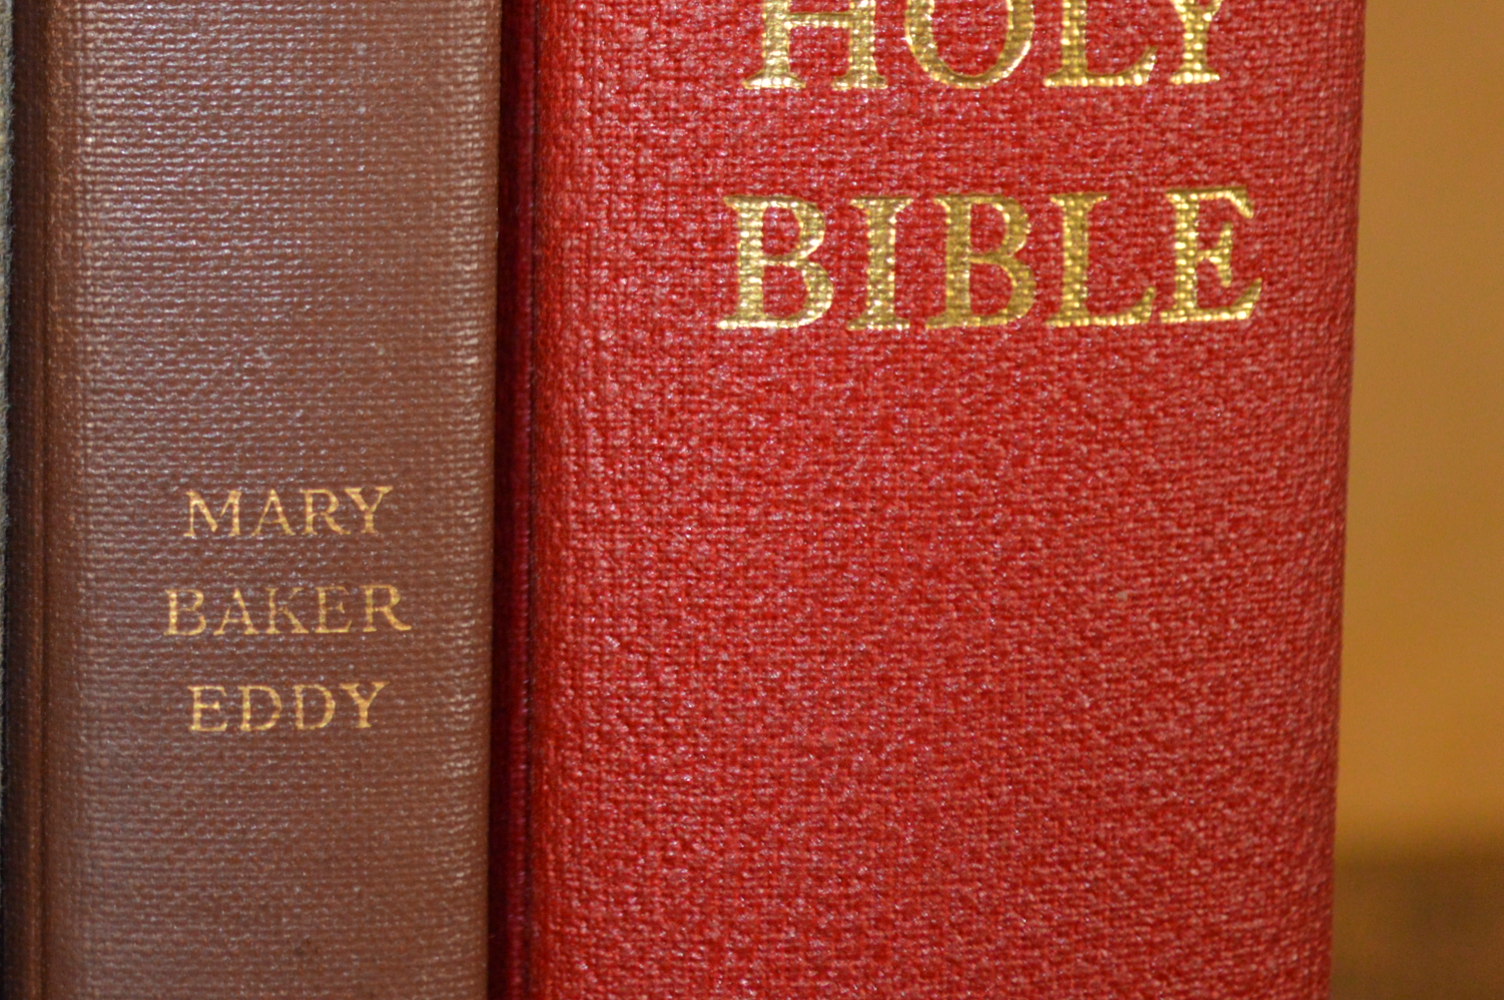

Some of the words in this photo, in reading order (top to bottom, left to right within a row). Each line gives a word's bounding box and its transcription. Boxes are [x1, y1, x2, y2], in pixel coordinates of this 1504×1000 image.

[715, 185, 1264, 331] BIBLE
[182, 485, 394, 537] MARY
[163, 583, 413, 637] BAKER
[187, 680, 391, 733] EDDY
